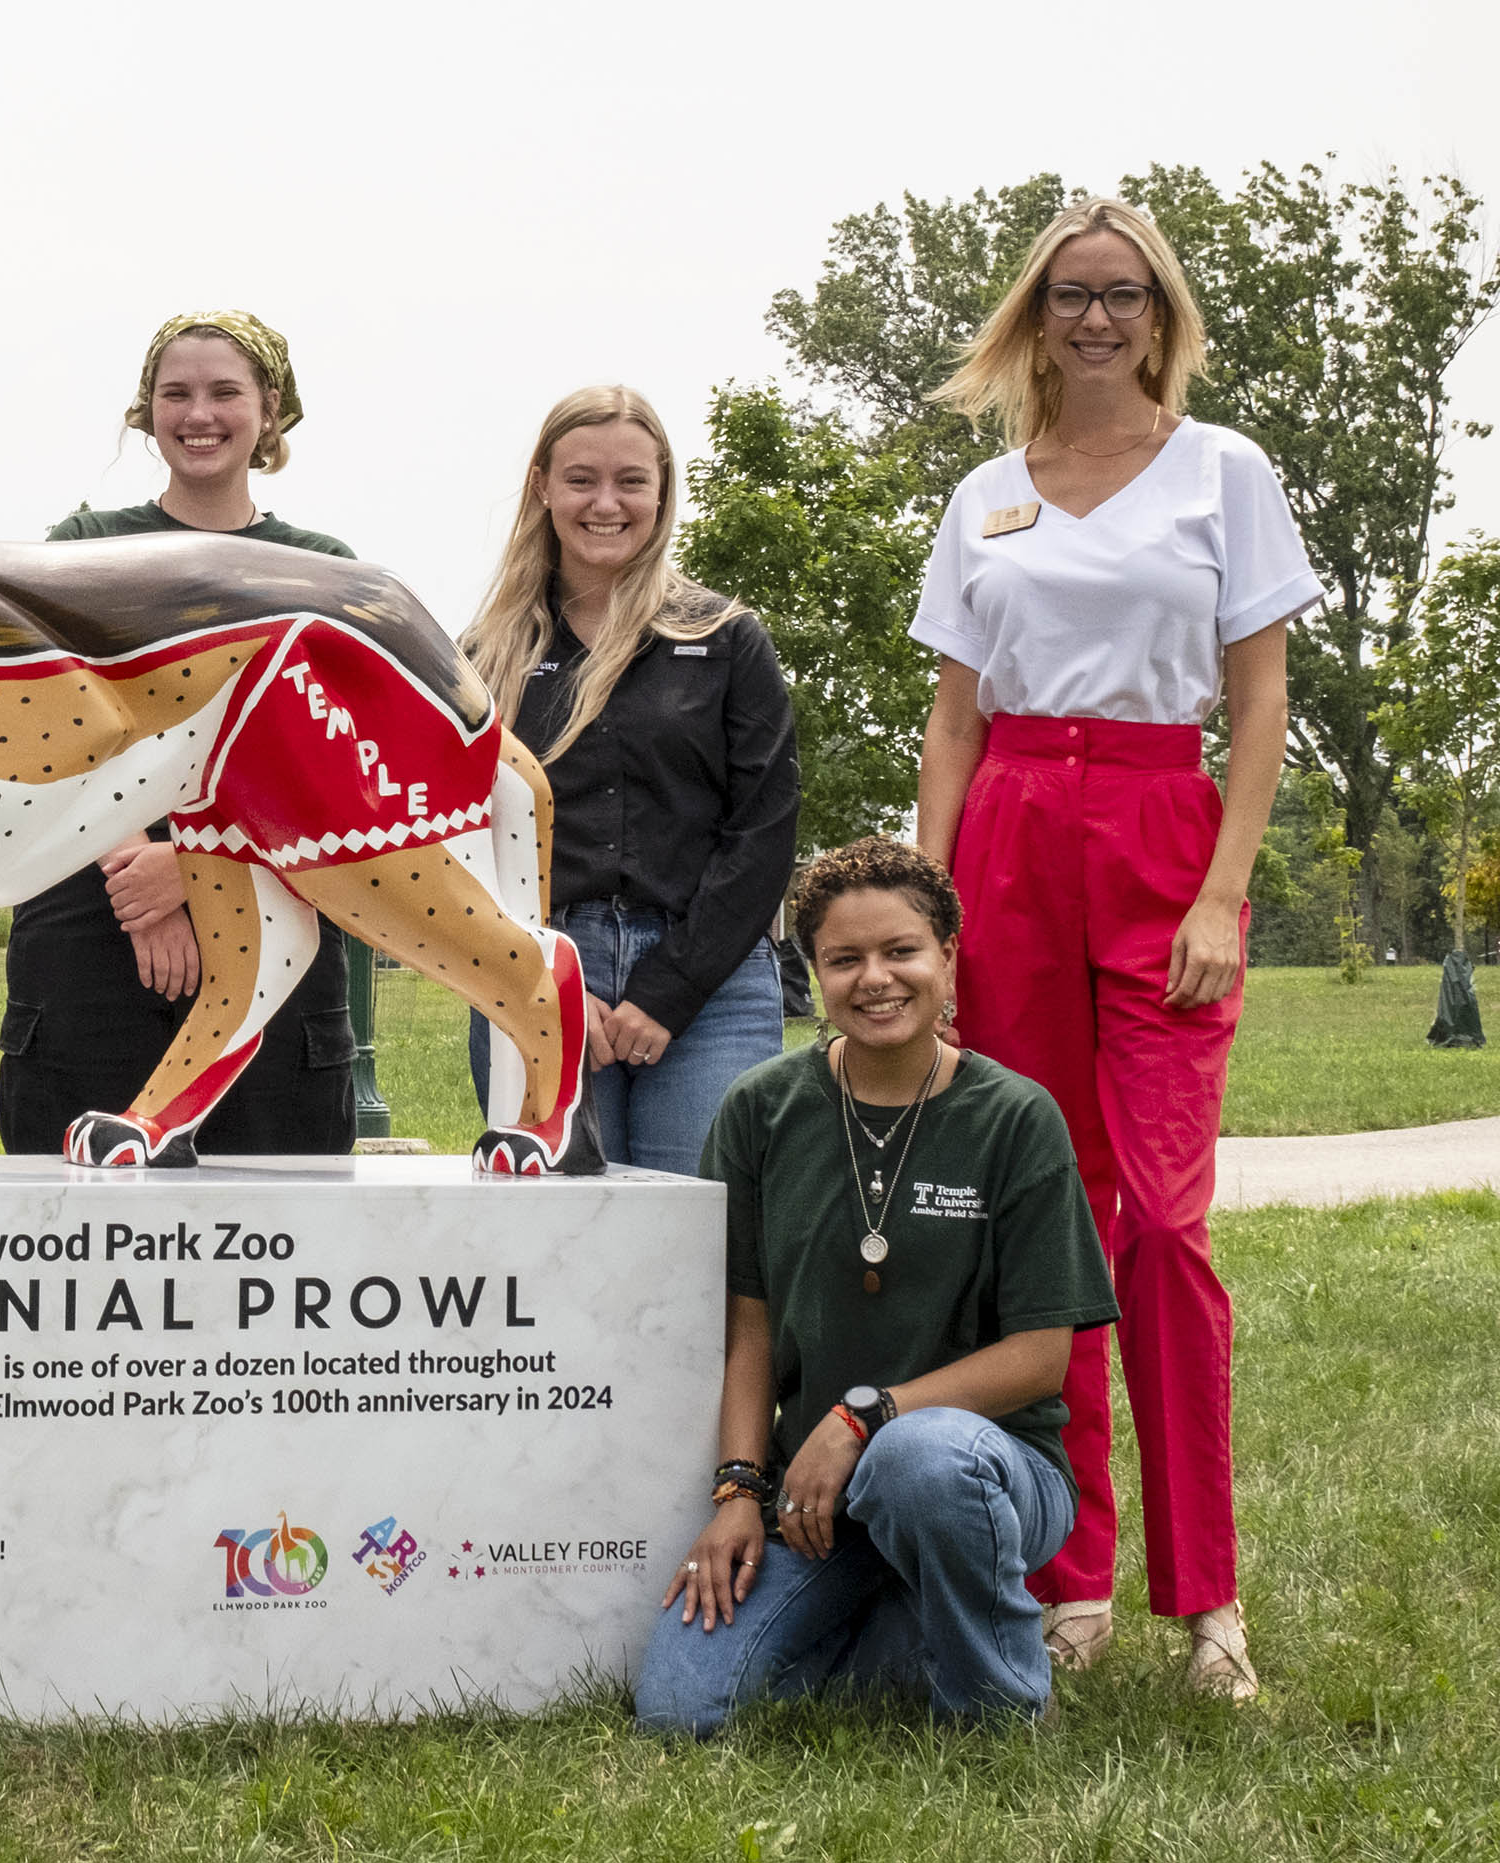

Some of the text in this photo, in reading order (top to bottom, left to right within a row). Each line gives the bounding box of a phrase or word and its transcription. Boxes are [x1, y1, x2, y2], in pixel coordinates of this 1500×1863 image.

[281, 661, 428, 816] TEMPLE
[936, 1184, 977, 1198] Temple
[909, 1206, 944, 1217] Ambler
[944, 1208, 966, 1218] Field
[106, 1223, 201, 1261] Park
[214, 1224, 294, 1261] Zoo
[239, 1276, 536, 1330] PROWL
[5, 1355, 25, 1379] is
[32, 1360, 84, 1379] one
[91, 1354, 120, 1378] of
[126, 1359, 187, 1378] over
[193, 1359, 207, 1377] a
[215, 1351, 295, 1376] dozen
[302, 1350, 401, 1375] located
[408, 1349, 556, 1376] throughout
[124, 1391, 185, 1416] Park
[193, 1390, 263, 1415] Zoo’s
[272, 1389, 349, 1414] 100th
[357, 1388, 511, 1416] anniversary
[518, 1387, 540, 1411] in
[548, 1386, 613, 1410] 2024
[214, 1527, 328, 1597] 100
[488, 1540, 648, 1562] VALLEY FORGE
[385, 1551, 427, 1597] MONTCO
[492, 1568, 499, 1576] &
[503, 1565, 578, 1576] MONTGOMERY
[632, 1563, 646, 1572] PA
[213, 1600, 328, 1611] ELMWOOD PARK ZOO
